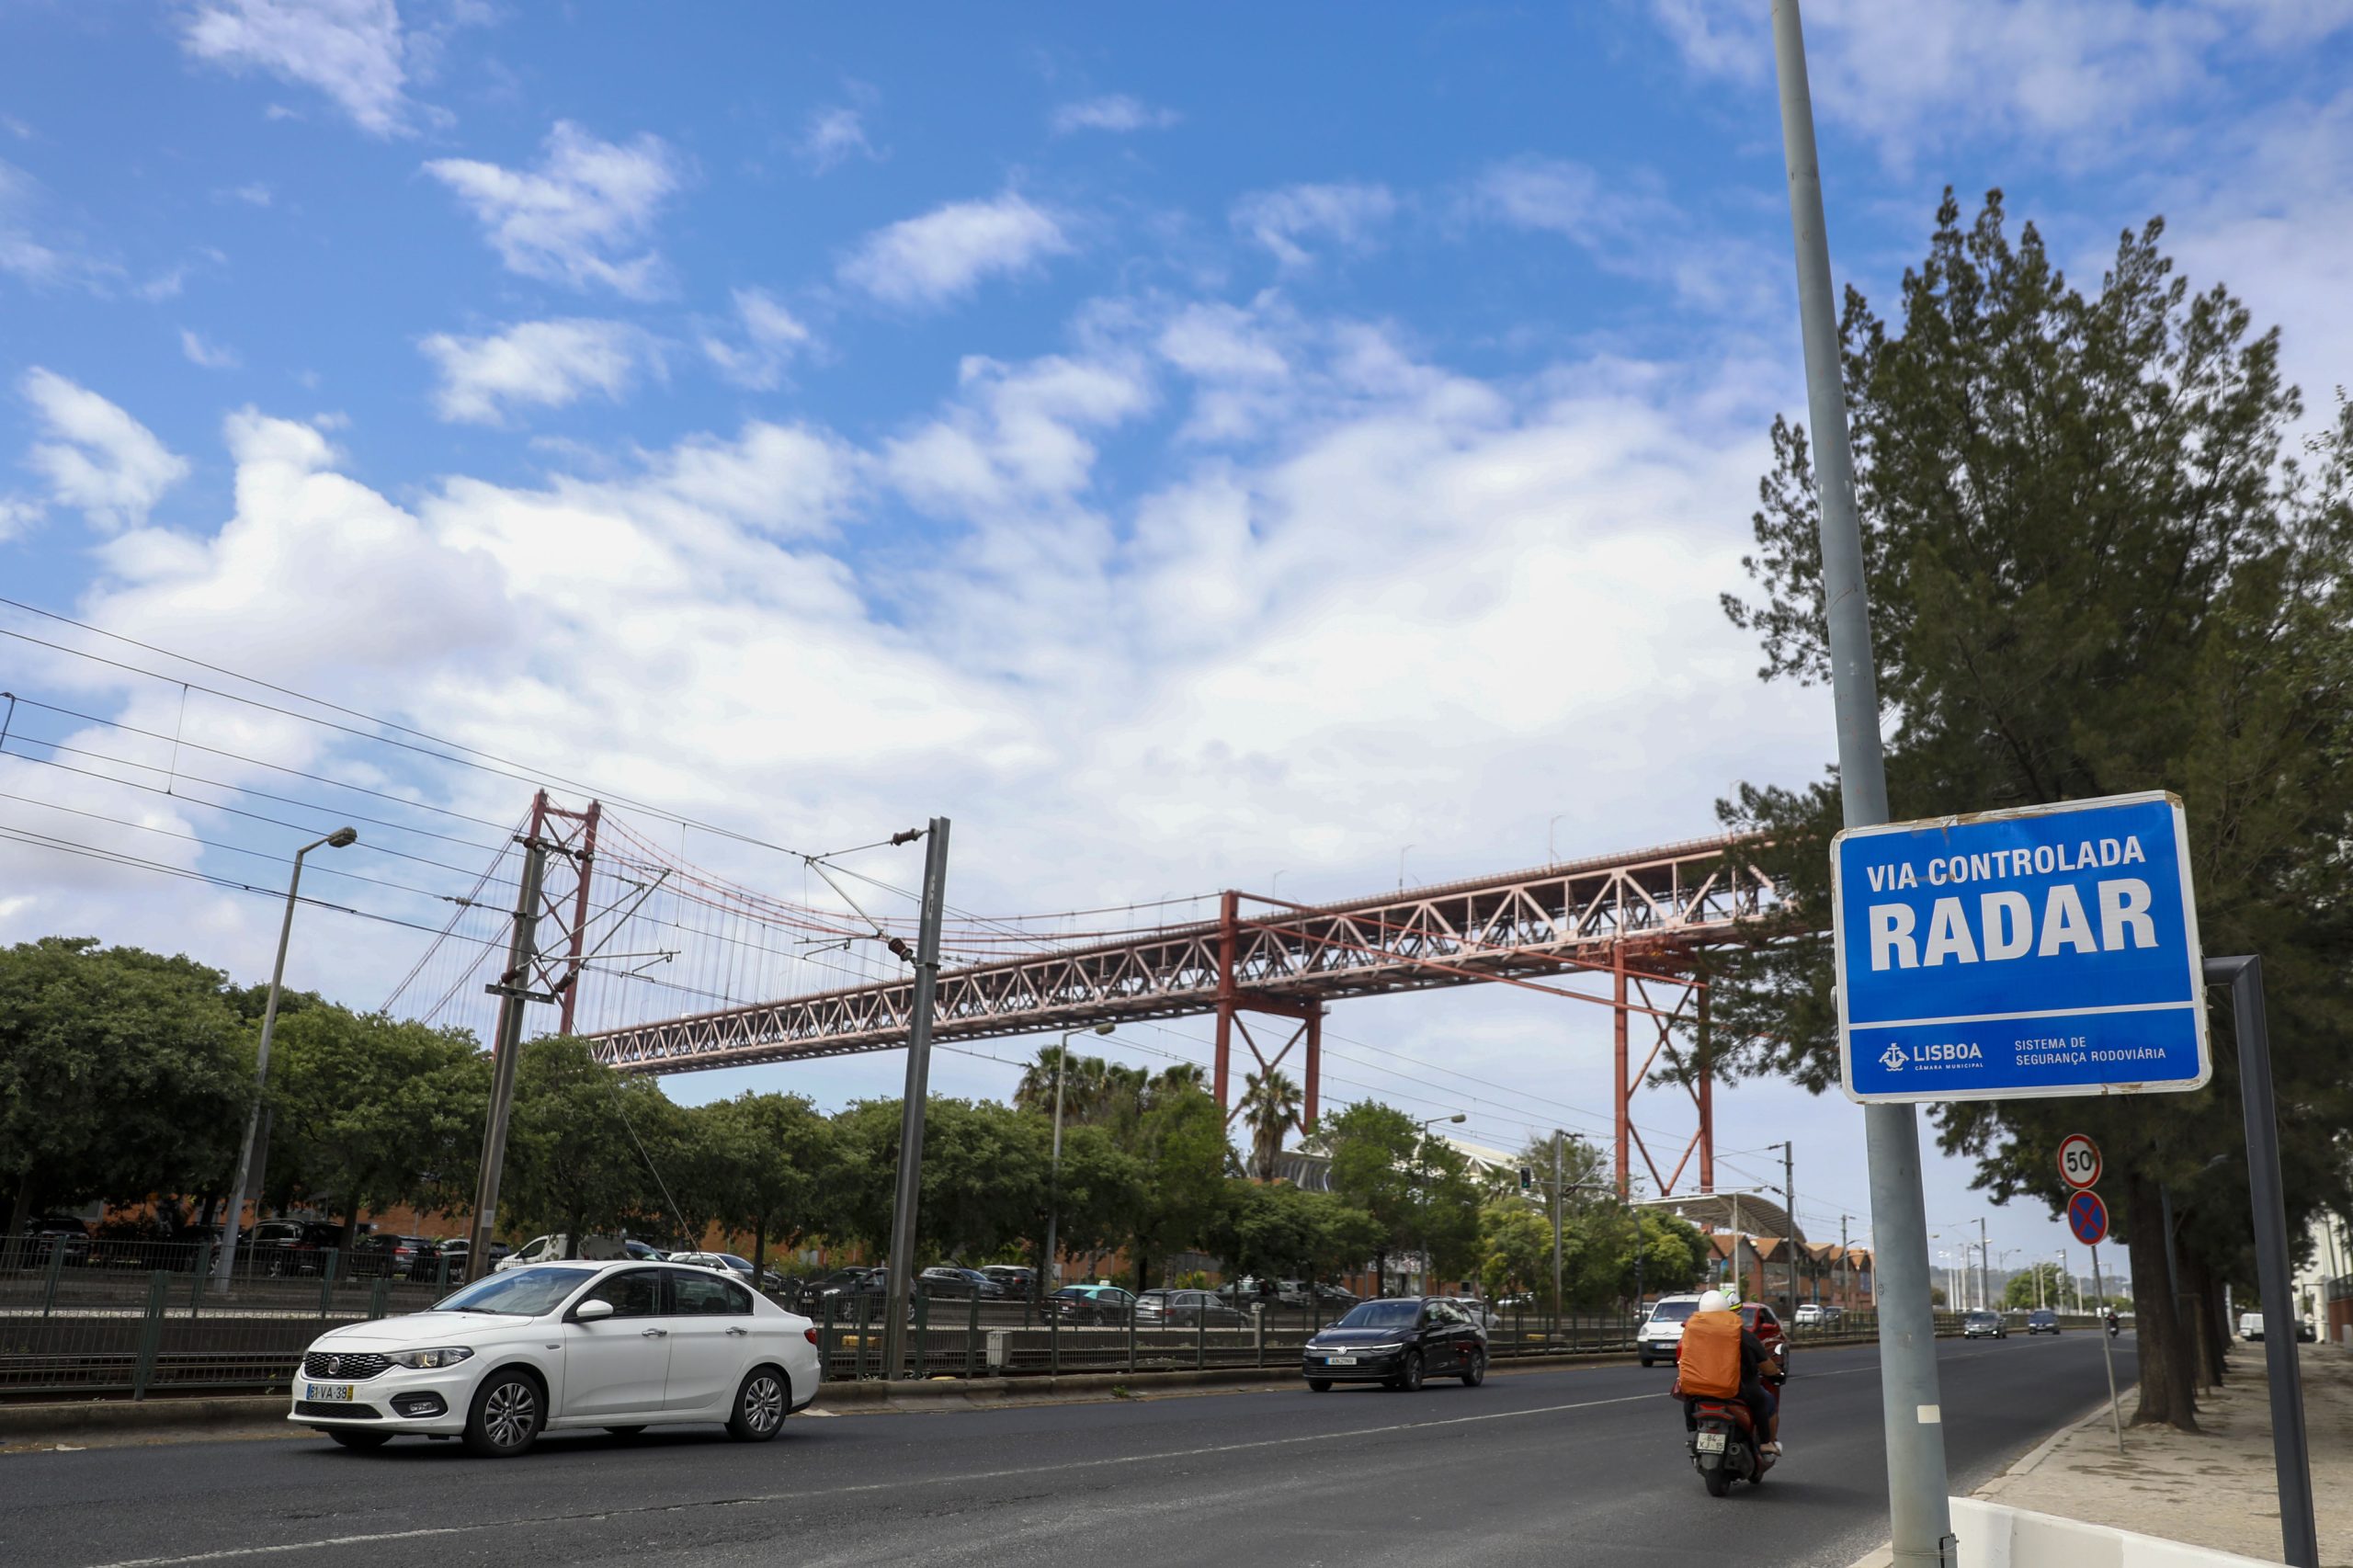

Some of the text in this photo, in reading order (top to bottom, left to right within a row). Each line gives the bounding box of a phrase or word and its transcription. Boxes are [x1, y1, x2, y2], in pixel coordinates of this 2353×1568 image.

[1867, 835, 2146, 892] VIA CONTROLADA
[1869, 878, 2160, 971] RADAR
[1913, 1042, 1983, 1062] LISBOA
[2015, 1037, 2086, 1051] SISTEMA DE
[2016, 1047, 2166, 1065] SEGURANÇA RODOVIÁRIA
[2067, 1150, 2092, 1173] 50
